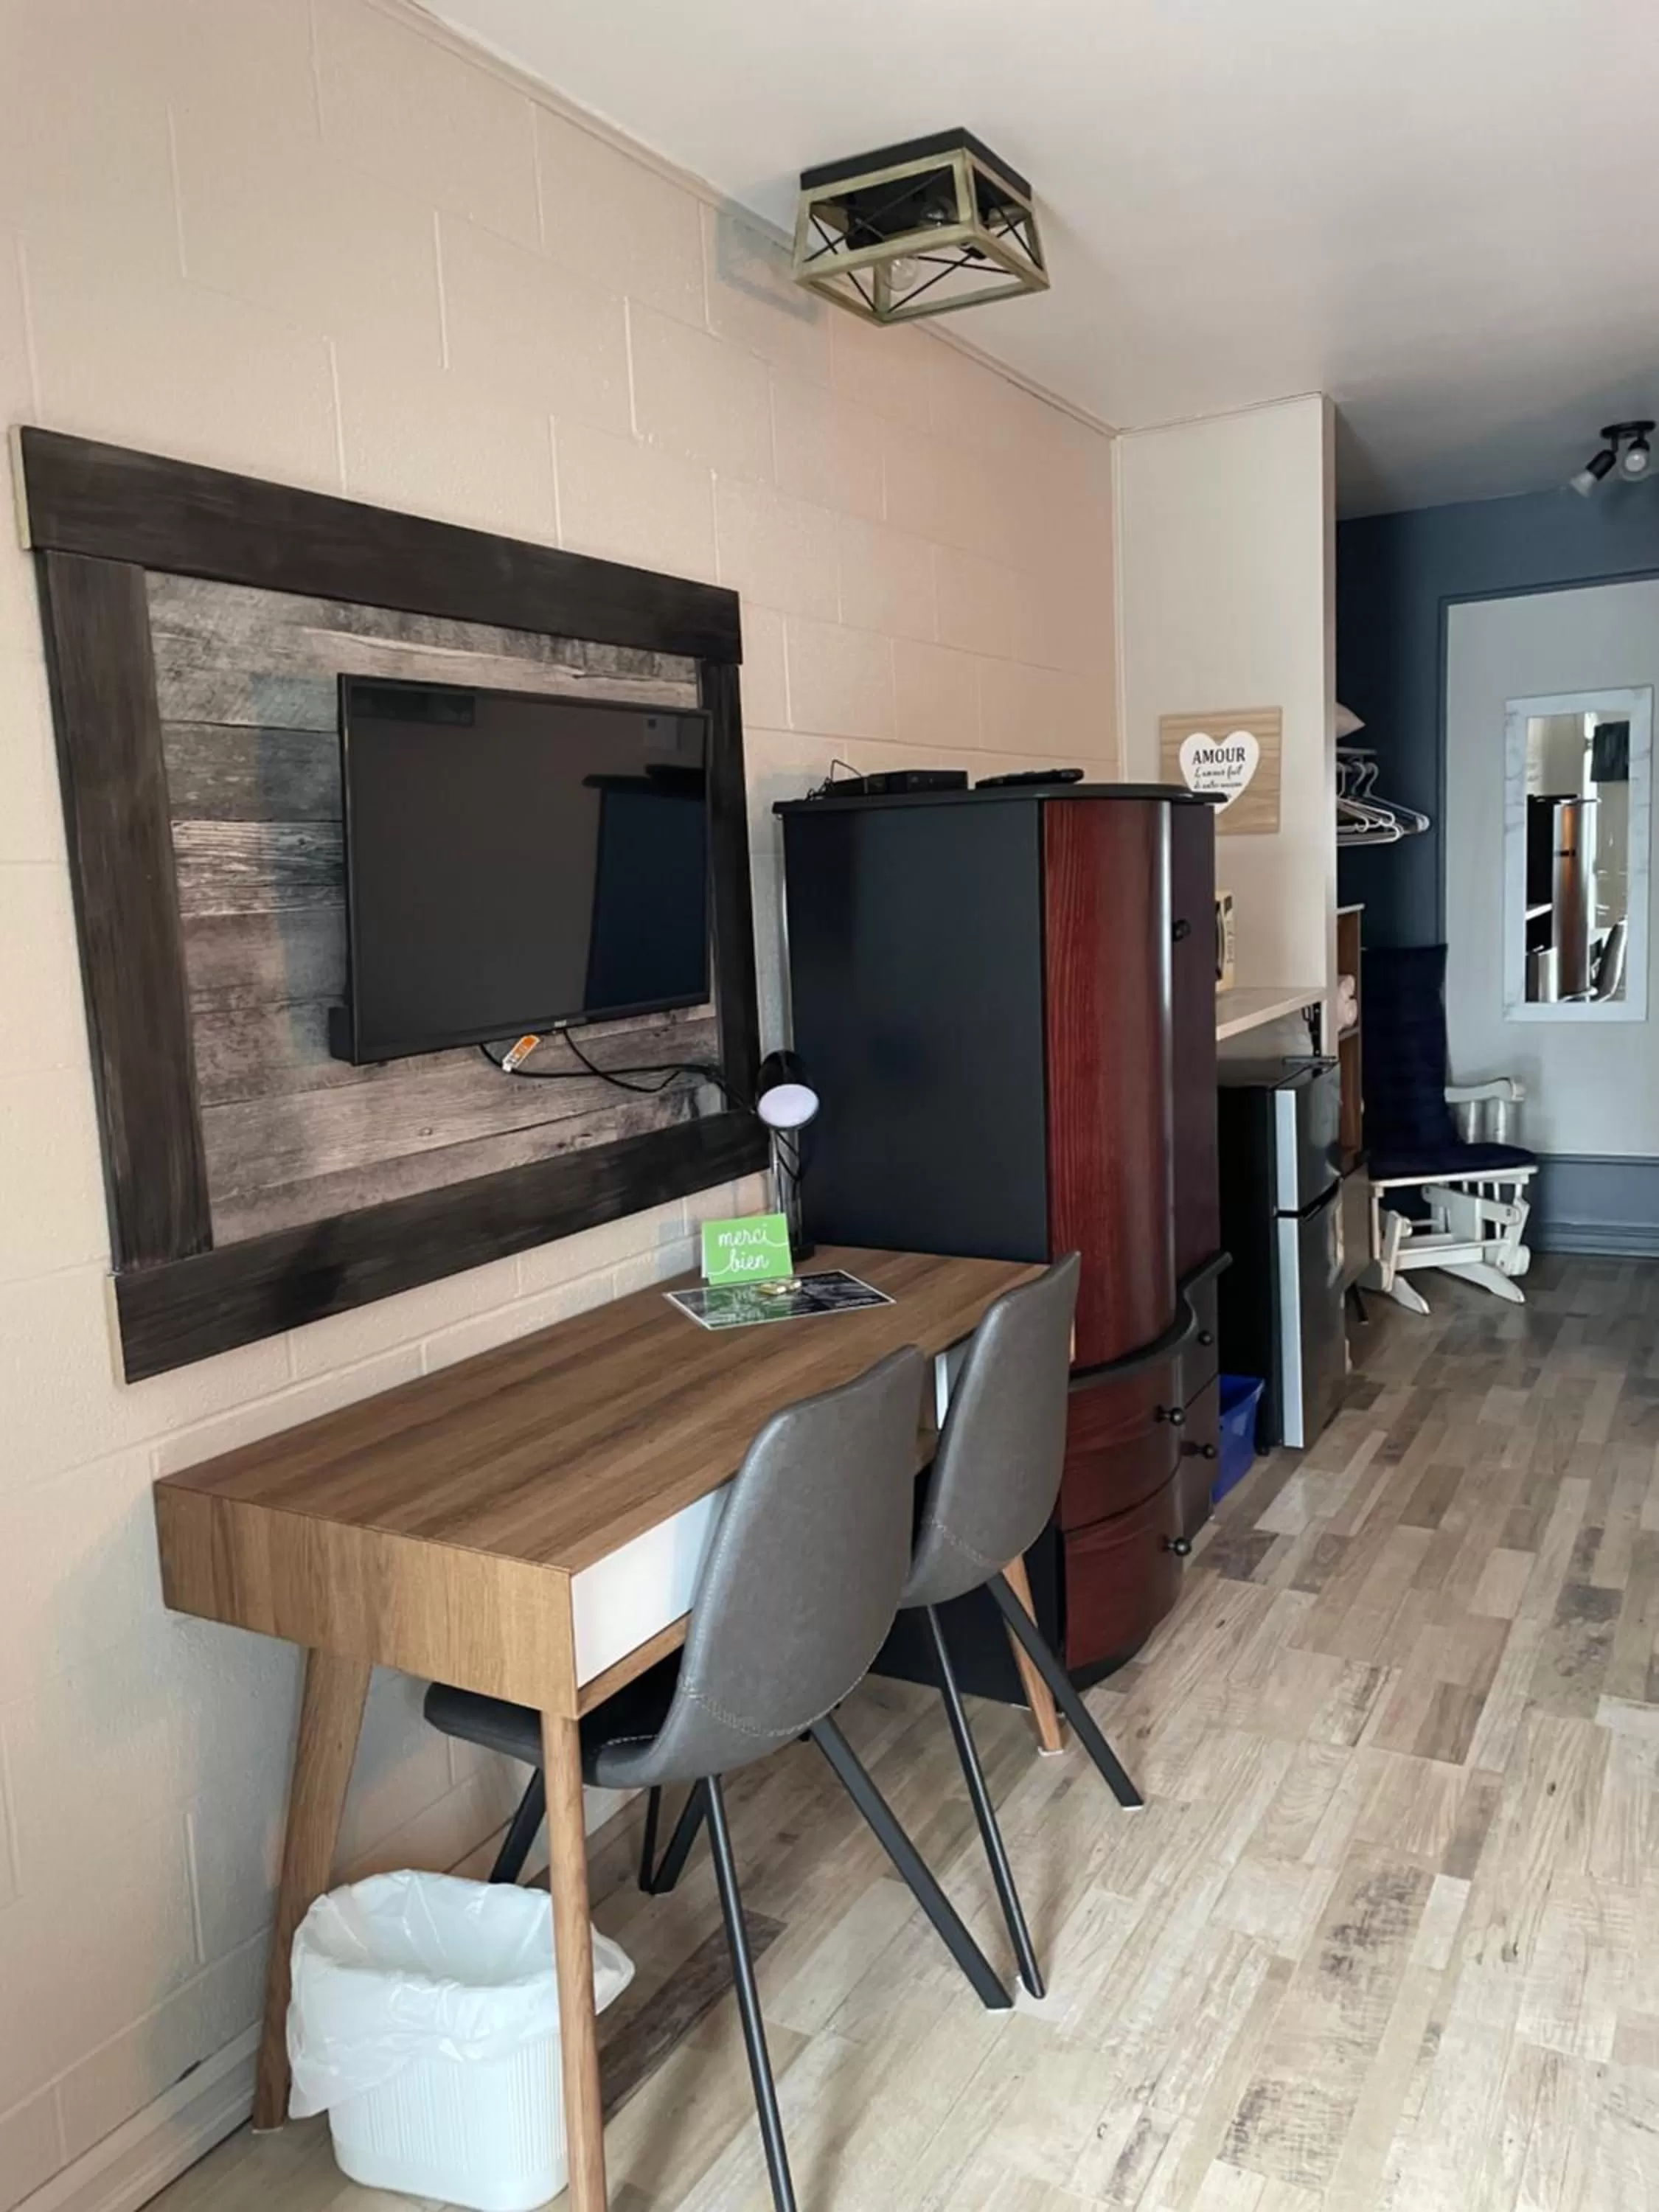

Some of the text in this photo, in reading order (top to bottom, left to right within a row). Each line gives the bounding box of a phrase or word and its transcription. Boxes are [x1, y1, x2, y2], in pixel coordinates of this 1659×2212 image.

[1192, 747, 1245, 764] AMOUR
[718, 1222, 787, 1246] merci
[709, 1248, 769, 1274] bien
